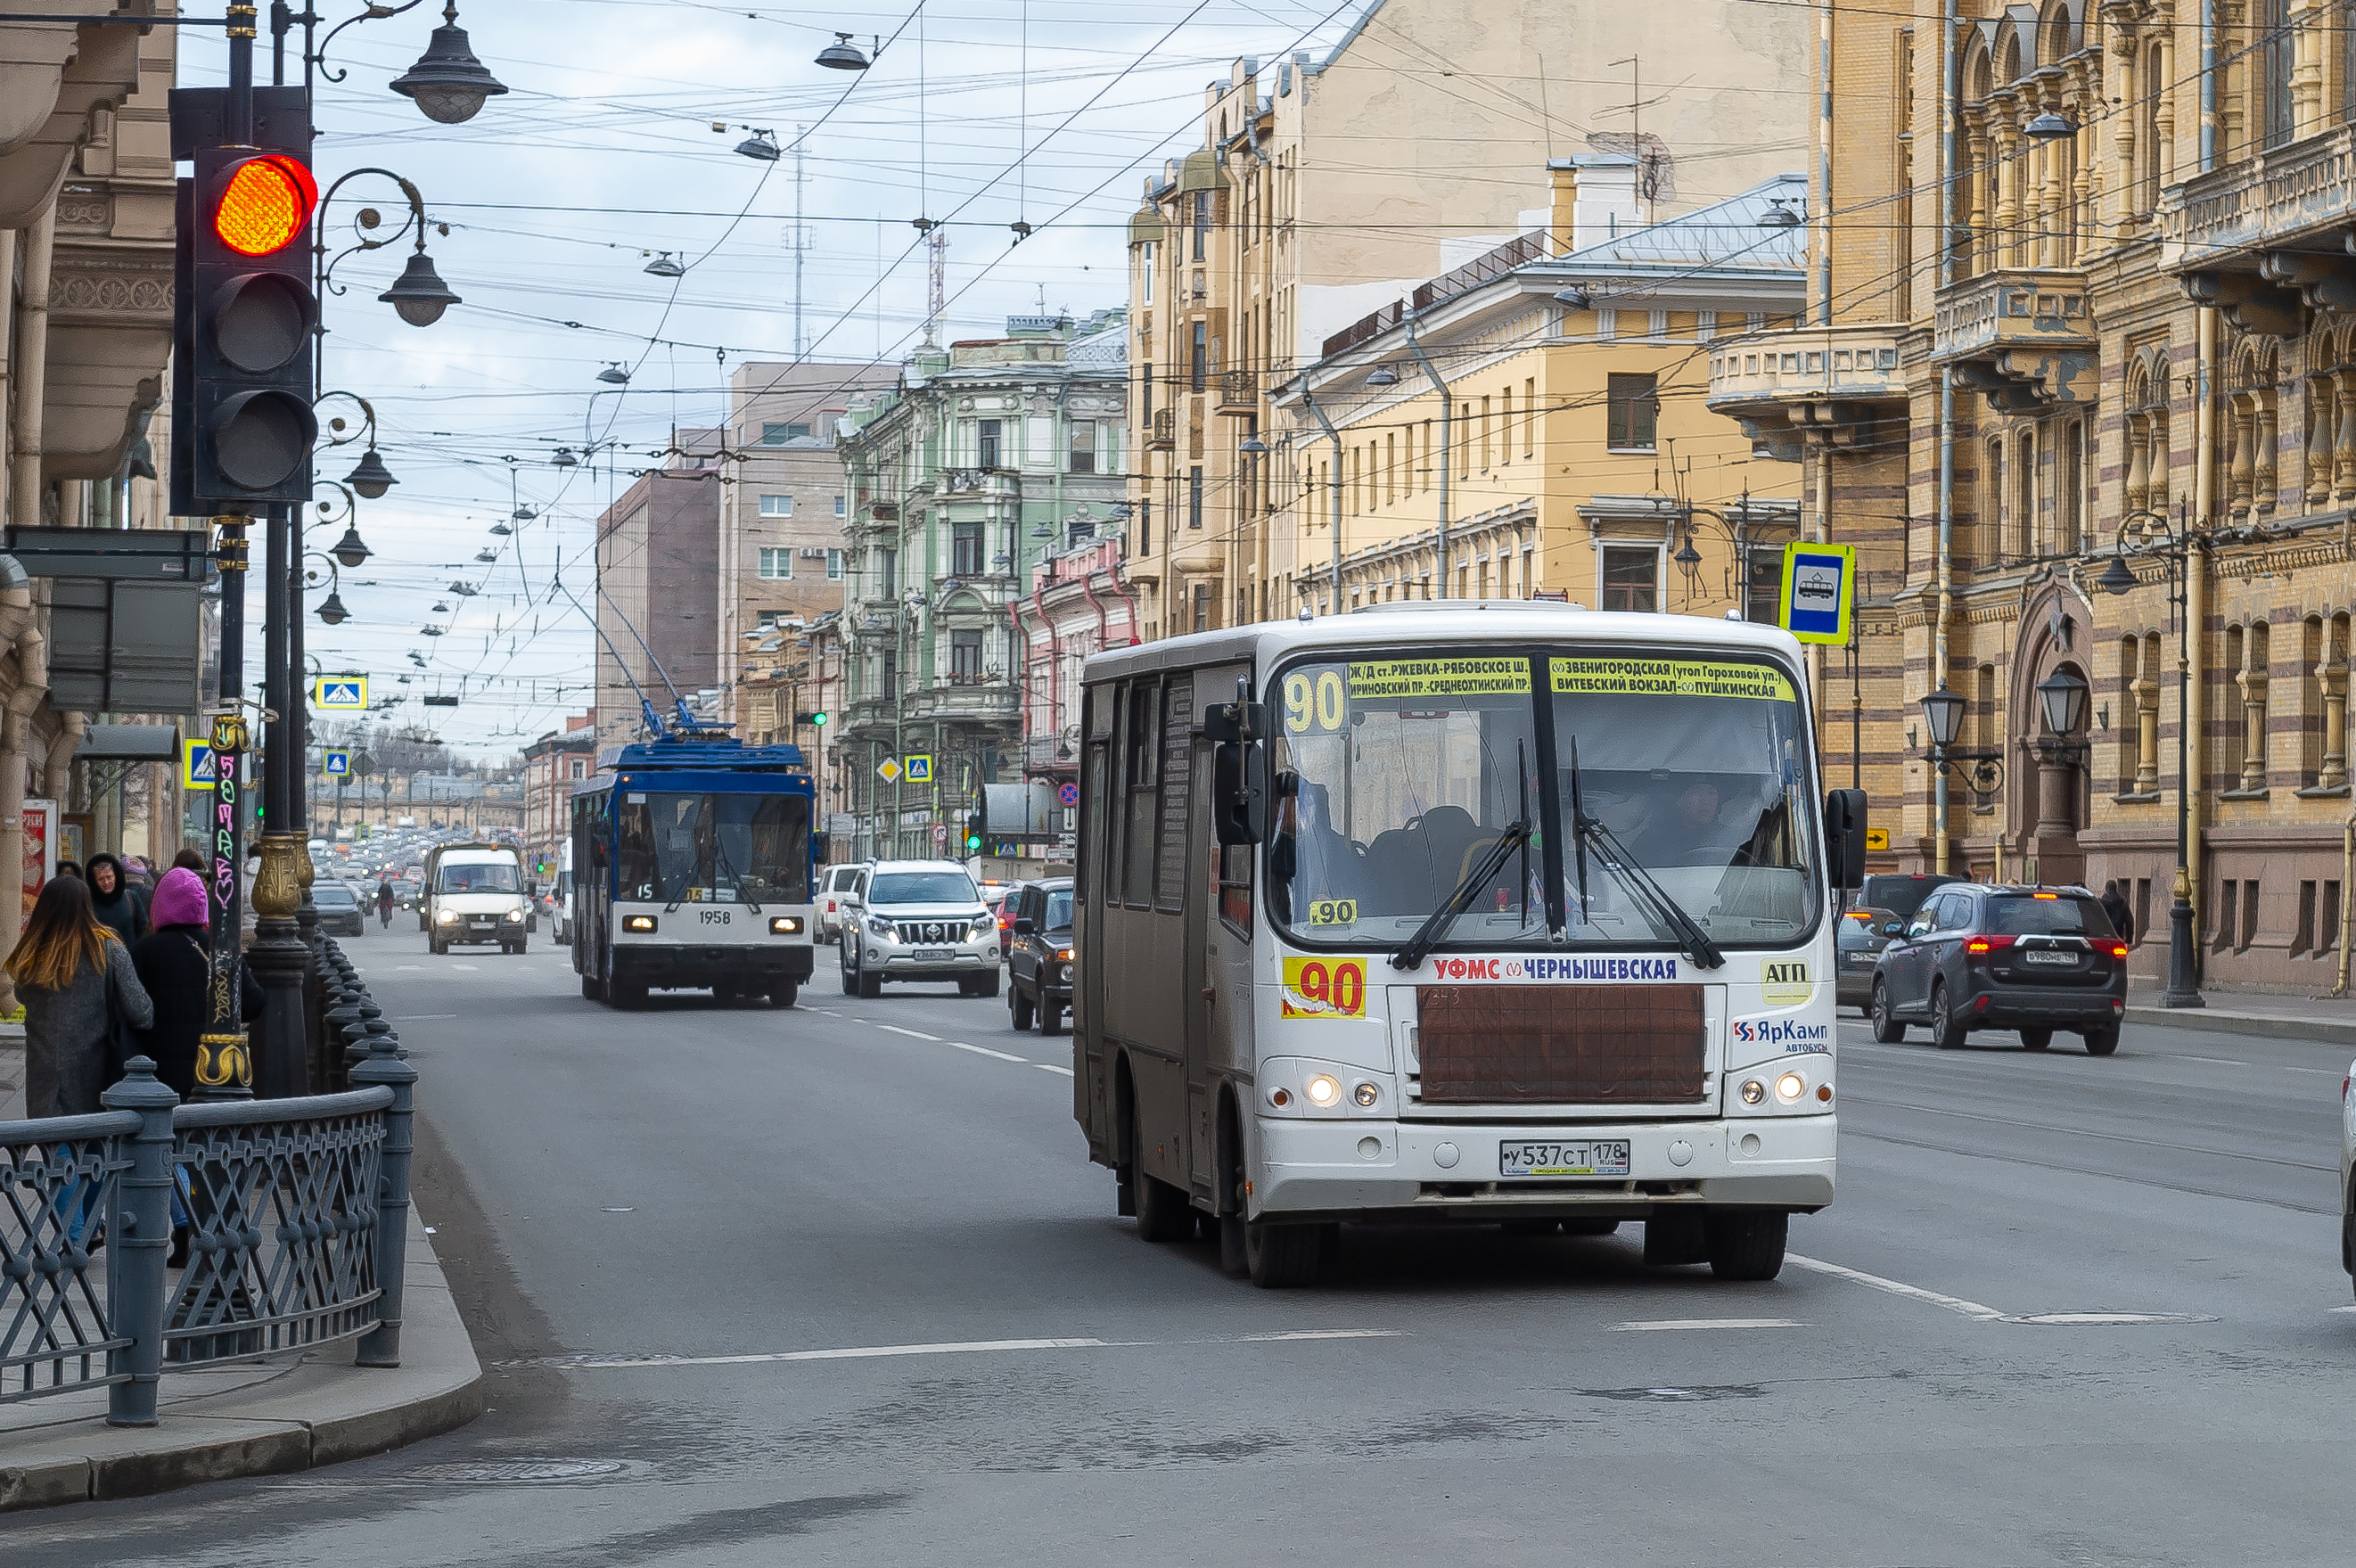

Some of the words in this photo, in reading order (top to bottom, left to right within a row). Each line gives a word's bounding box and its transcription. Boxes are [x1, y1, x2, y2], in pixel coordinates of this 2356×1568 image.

[1350, 665, 1375, 681] Ж/Д
[1513, 661, 1529, 673] Ш.
[1565, 661, 1671, 677] ЗВЕНИГОРОДСКАЯ
[1672, 663, 1701, 680] (угол
[1703, 665, 1761, 681] Гороховой
[1761, 671, 1781, 685] ул.)
[1350, 678, 1410, 696] ИРИНОВСКИЙ
[1515, 677, 1531, 690] ПР.
[1556, 676, 1626, 691] ВИТЕБСКИЙ
[1695, 682, 1777, 697] ПУШКИНСКАЯ
[1285, 670, 1344, 733] 90
[637, 883, 653, 899] 15
[699, 910, 731, 925] 1958
[1433, 958, 1499, 980] УФМС
[1523, 959, 1677, 980] ЧЕРНЫШЕВСКАЯ
[1766, 963, 1806, 982] АТП
[1758, 1020, 1827, 1044] ЯрКамп
[1785, 1043, 1828, 1053] АВТОБУСЫ
[1509, 1145, 1588, 1166] У537СТ
[1594, 1144, 1622, 1160] 178
